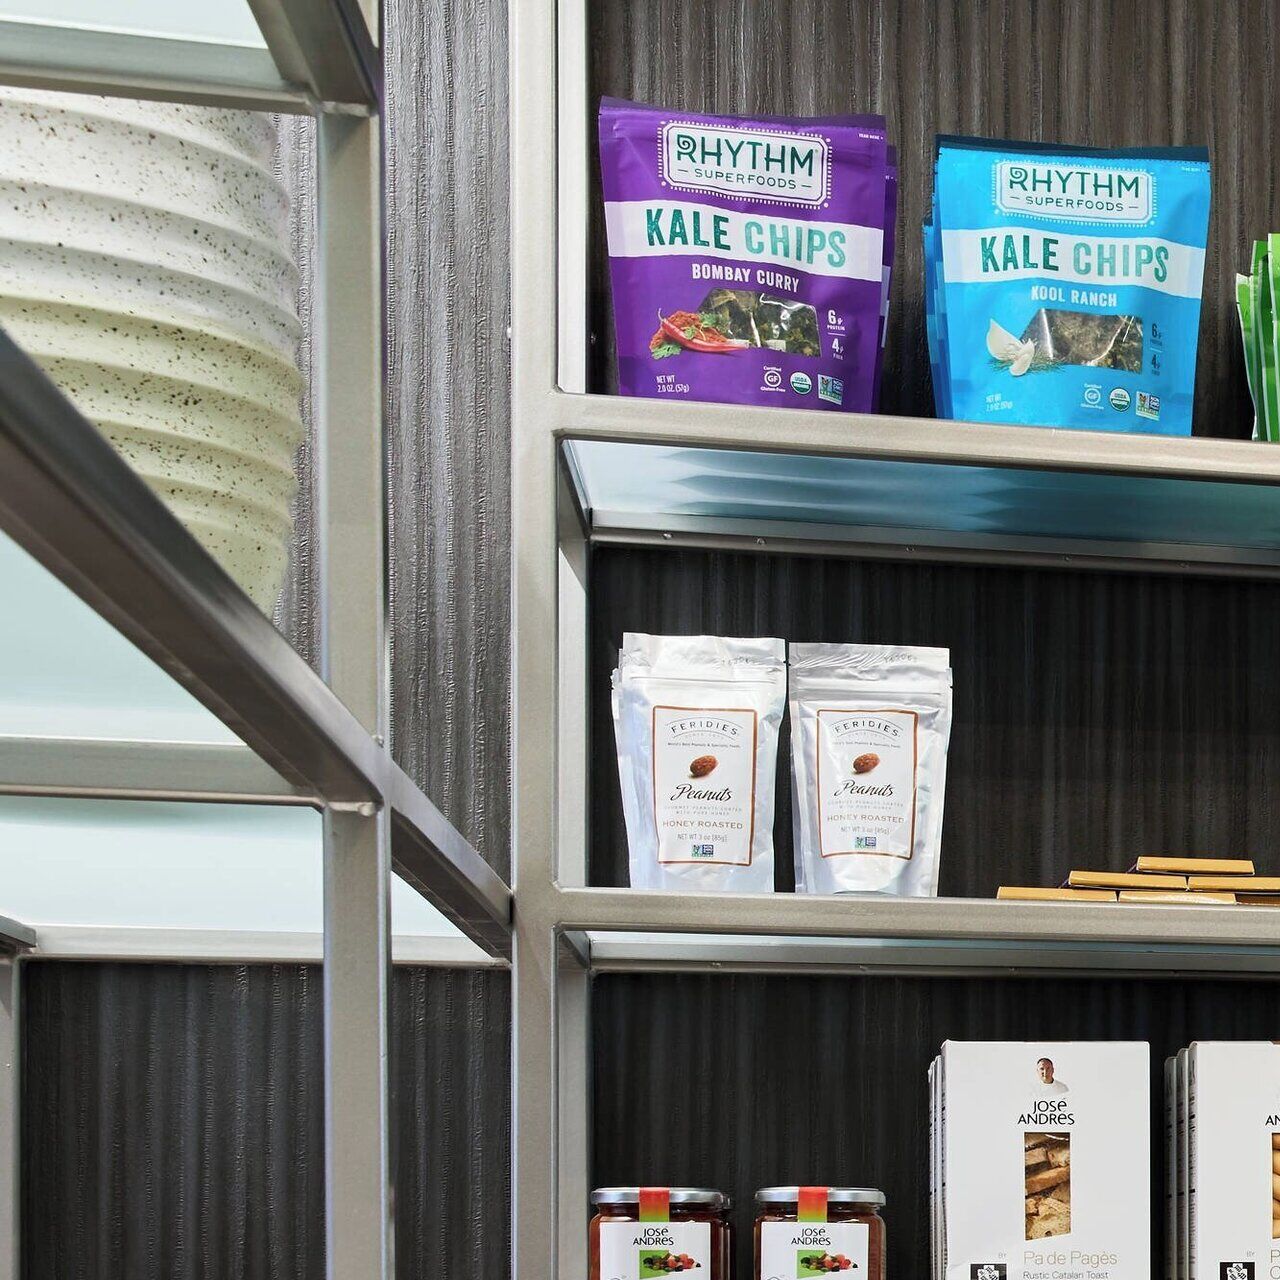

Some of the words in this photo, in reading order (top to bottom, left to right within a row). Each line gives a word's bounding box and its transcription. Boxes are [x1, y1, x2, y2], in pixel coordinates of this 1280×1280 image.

[677, 134, 814, 177] RHYTHM
[695, 168, 796, 190] SUPERFOODS
[1009, 167, 1139, 199] RHYTHM
[1026, 196, 1123, 212] SUPERFOODS
[646, 208, 731, 251] KALE
[745, 222, 846, 268] CHIPS
[980, 234, 1059, 273] KALE
[1073, 242, 1169, 283] CHIPS
[692, 263, 750, 282] BOMBAY
[756, 270, 799, 293] CURRY
[1031, 286, 1065, 303] KOOL
[1070, 289, 1118, 307] RANCH
[656, 375, 666, 383] NET
[667, 374, 675, 383] WT
[767, 375, 778, 383] GF
[671, 720, 738, 735] FERIDIES
[835, 720, 899, 737] FERIDIES
[670, 783, 733, 802] Peanuts
[834, 780, 894, 797] Peanuts
[663, 820, 694, 828] HONEY
[698, 821, 743, 830] ROASTED
[861, 814, 905, 824] ROASTED
[1023, 1251, 1044, 1265] Pa
[1046, 1251, 1067, 1265] de
[1023, 1271, 1049, 1280] Rustic
[1052, 1271, 1084, 1280] Catalan
[1087, 1271, 1109, 1280] Toast
